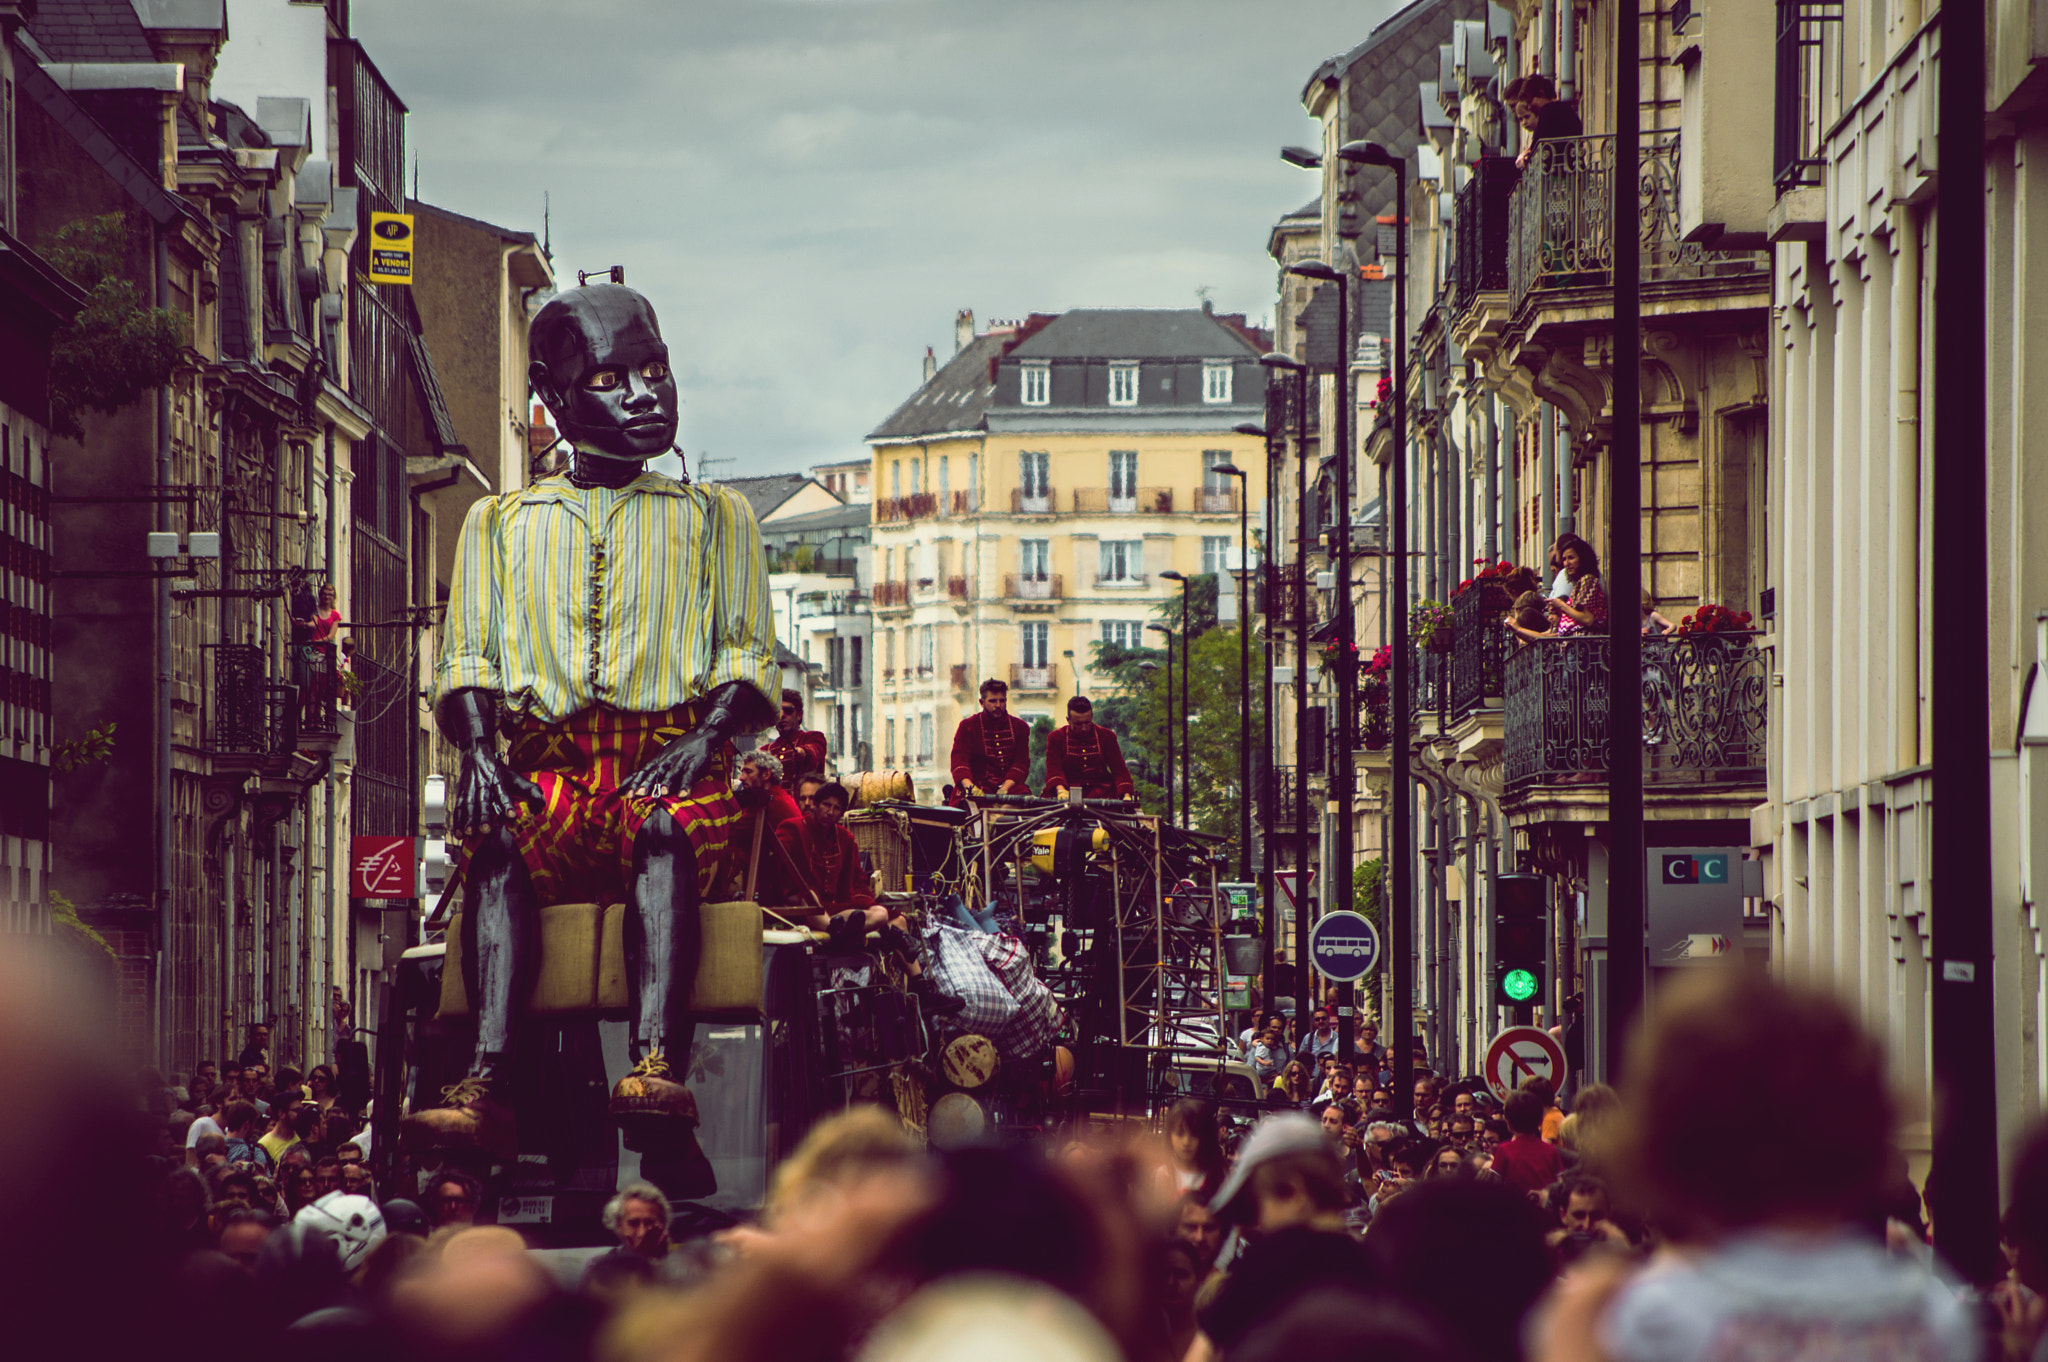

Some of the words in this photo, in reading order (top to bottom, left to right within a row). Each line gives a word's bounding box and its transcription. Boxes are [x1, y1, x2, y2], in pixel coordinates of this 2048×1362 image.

[386, 223, 399, 238] AJP
[373, 256, 380, 266] A
[381, 257, 409, 268] VENDRE
[1033, 846, 1050, 855] Yale
[1668, 859, 1722, 879] CIC
